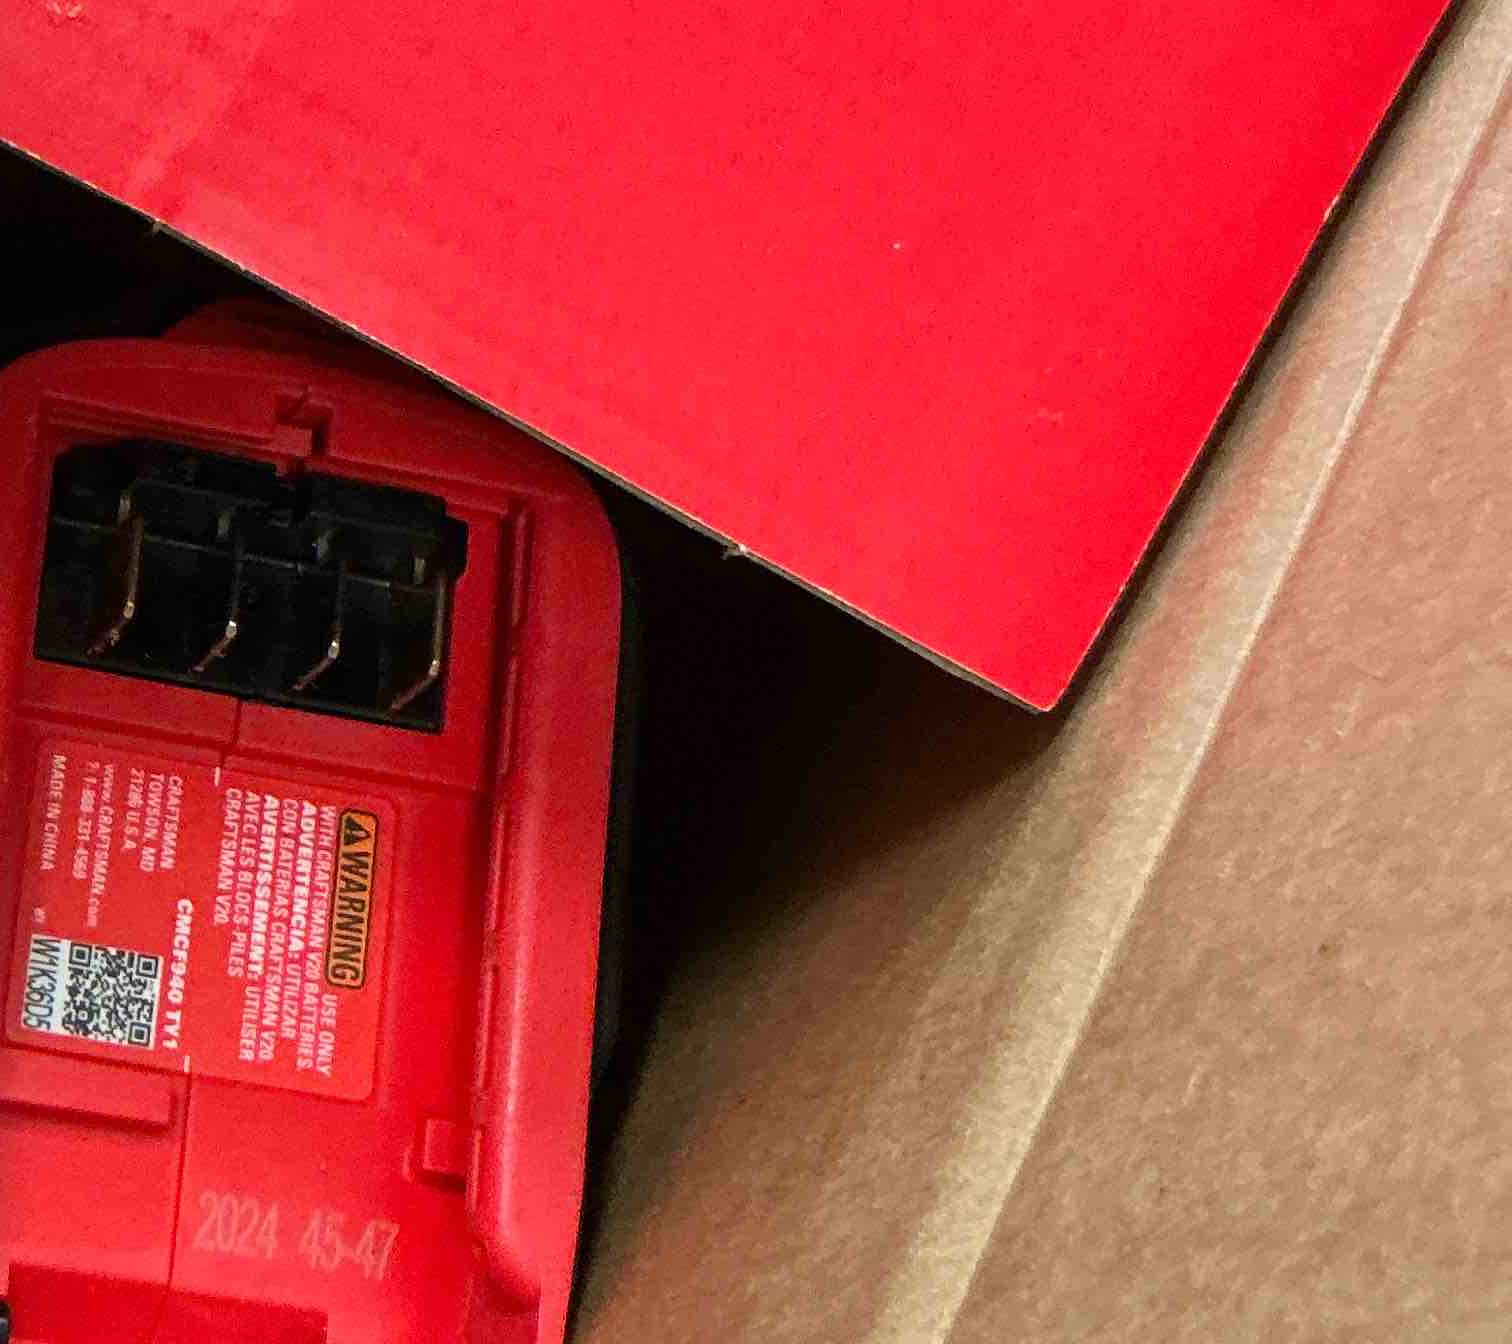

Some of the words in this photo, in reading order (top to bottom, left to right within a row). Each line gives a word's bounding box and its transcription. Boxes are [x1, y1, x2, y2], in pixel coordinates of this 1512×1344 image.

[46, 803, 61, 819] IN
[51, 755, 67, 799] MADE
[40, 822, 58, 870] CHINA
[160, 776, 183, 869] CRAFTSMAN
[217, 788, 242, 889] CRAFTSMAN
[243, 792, 260, 834] AVEC
[281, 799, 298, 832] CON
[320, 805, 337, 847] WITH
[140, 847, 156, 872] MD
[238, 838, 256, 867] LES
[247, 795, 280, 981] AVERTISSEMENT:
[288, 800, 317, 958] ADVERTENCIA:
[309, 850, 331, 948] CRAFTSMAN
[332, 851, 371, 980] WARNING
[23, 939, 62, 1030] W1K36D5
[167, 899, 194, 1004] CMCF940
[262, 922, 288, 1025] CRAFTSMAN
[307, 952, 322, 977] V20
[238, 986, 260, 1062] UTILISER
[280, 964, 301, 1039] UTILIZAR
[320, 994, 338, 1029] USE
[316, 1031, 335, 1076] ONLY
[192, 1190, 280, 1261] 2024
